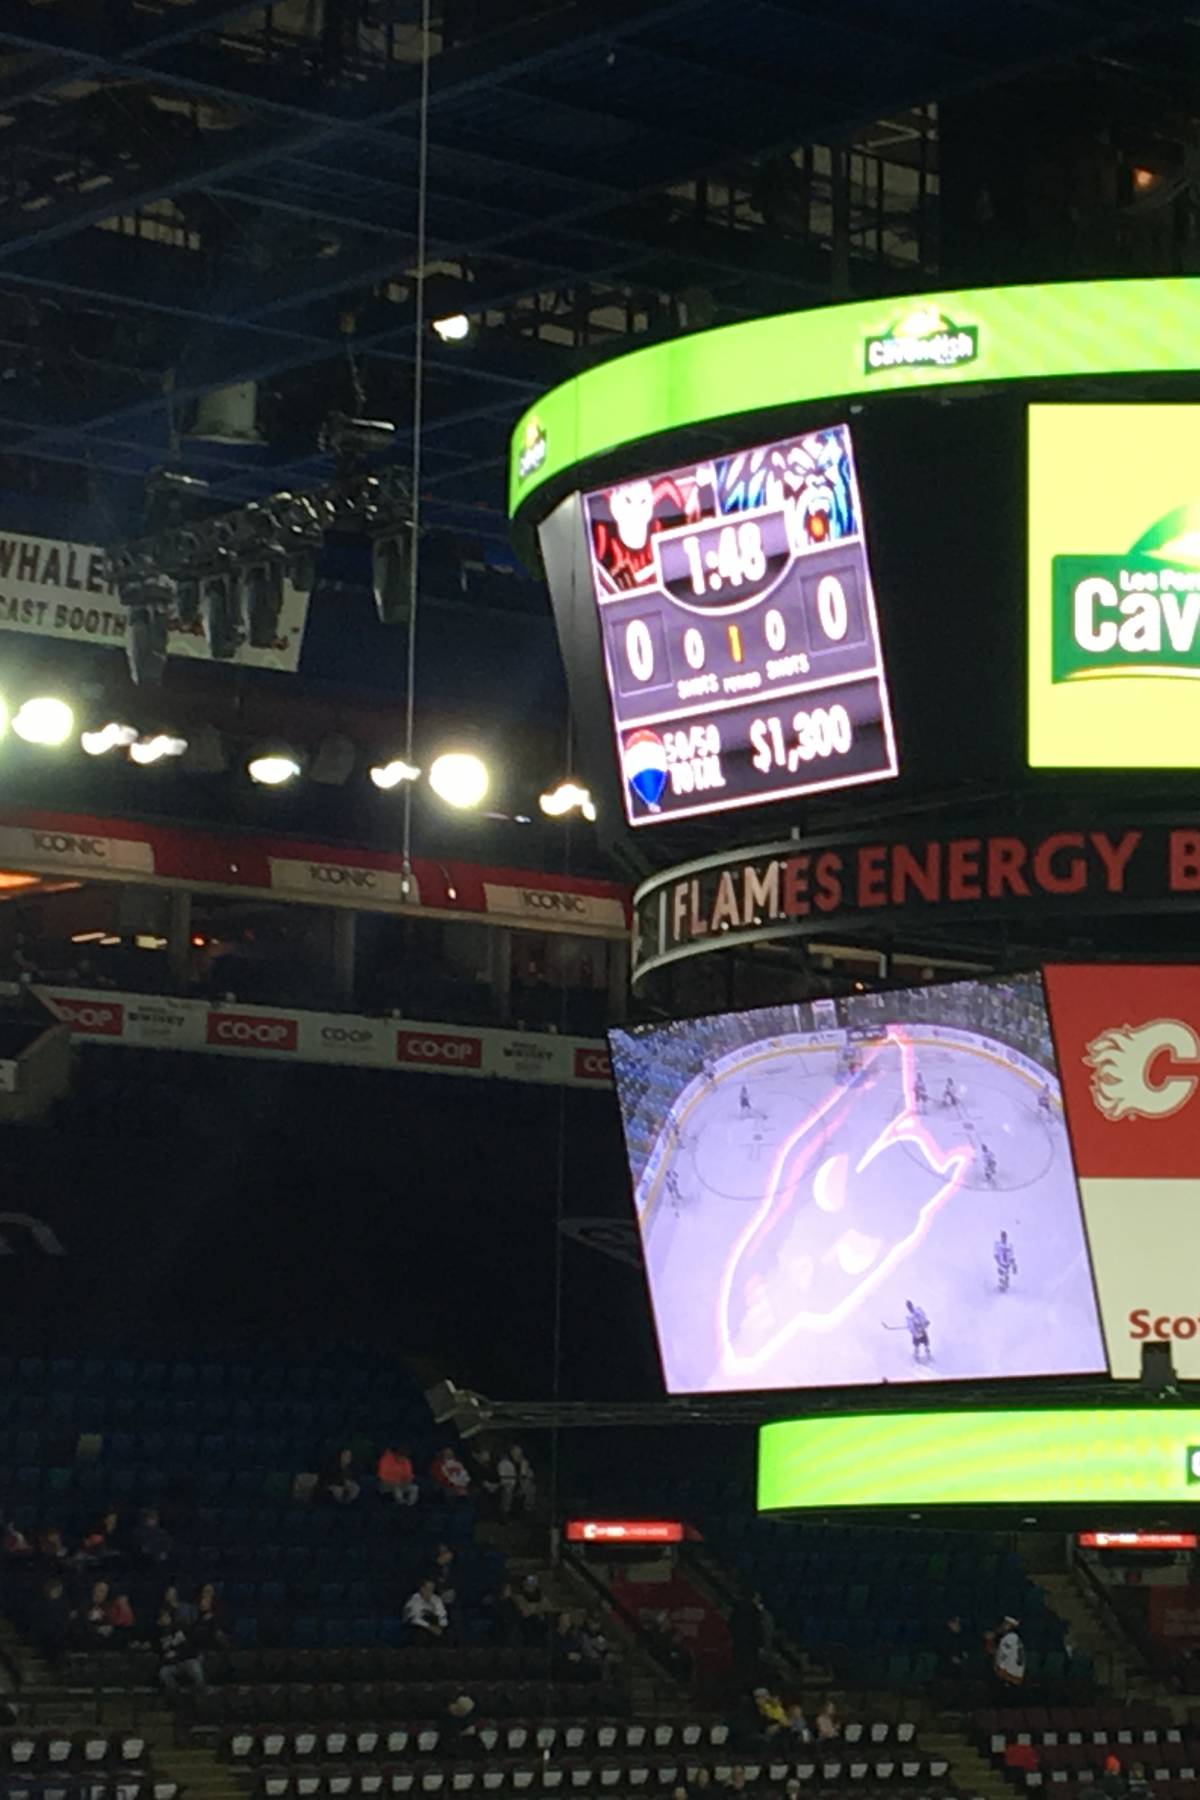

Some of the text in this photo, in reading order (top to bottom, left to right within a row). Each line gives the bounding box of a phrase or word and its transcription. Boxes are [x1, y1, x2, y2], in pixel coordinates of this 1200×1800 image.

[683, 522, 766, 595] 1:48
[54, 603, 128, 637] BOOTH
[817, 575, 848, 640] 0
[626, 619, 653, 681] 0
[684, 628, 705, 669] 0
[765, 609, 786, 651] 0
[750, 704, 851, 773] $1,300
[672, 851, 842, 941] FLAMES
[857, 831, 1142, 908] ENERGY
[216, 1021, 288, 1043] CO-OP
[406, 1038, 473, 1060] CO-OP
